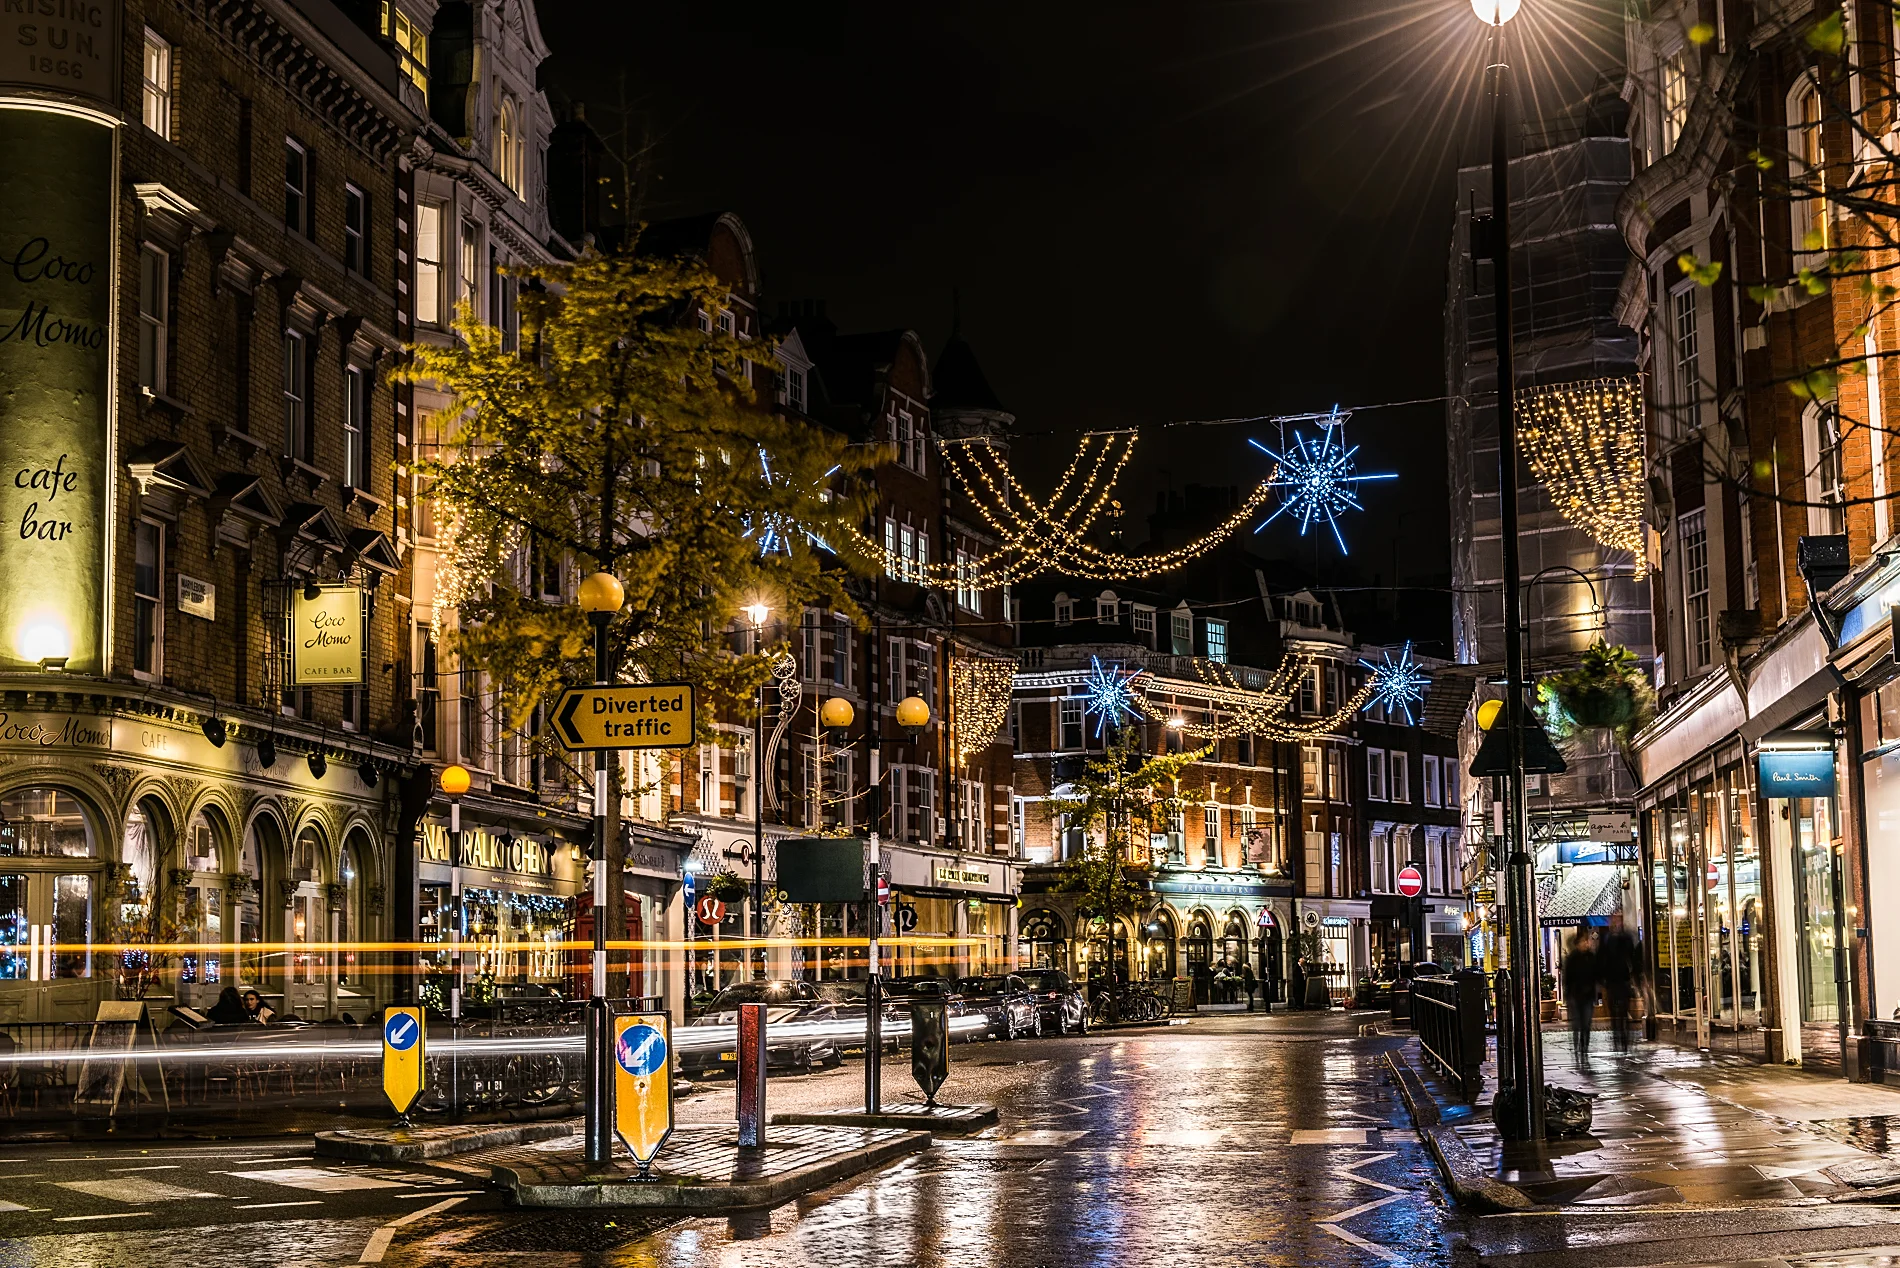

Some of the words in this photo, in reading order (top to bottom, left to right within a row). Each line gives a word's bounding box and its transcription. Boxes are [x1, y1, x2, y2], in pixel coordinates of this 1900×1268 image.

[5, 0, 102, 28] RISING
[18, 24, 100, 60] SUN.
[29, 55, 83, 80] 1866
[0, 237, 96, 284] Coco
[0, 300, 105, 349] Momo
[14, 453, 78, 502] cafe
[19, 501, 73, 541] bar
[309, 610, 346, 630] Coco
[304, 630, 352, 649] Momo
[304, 667, 328, 675] CAFE
[333, 666, 353, 674] BAR
[592, 693, 683, 715] Diverted
[39, 717, 111, 747] Momo
[604, 718, 672, 737] traffic
[141, 731, 168, 751] CAFE
[243, 747, 264, 774] Coc
[1772, 771, 1792, 782] Paul
[1793, 772, 1821, 782] Smith
[1182, 884, 1216, 893] PRINCE
[1220, 885, 1254, 894] REGENT
[452, 910, 458, 918] 6
[1543, 918, 1581, 927] GETTI.COM
